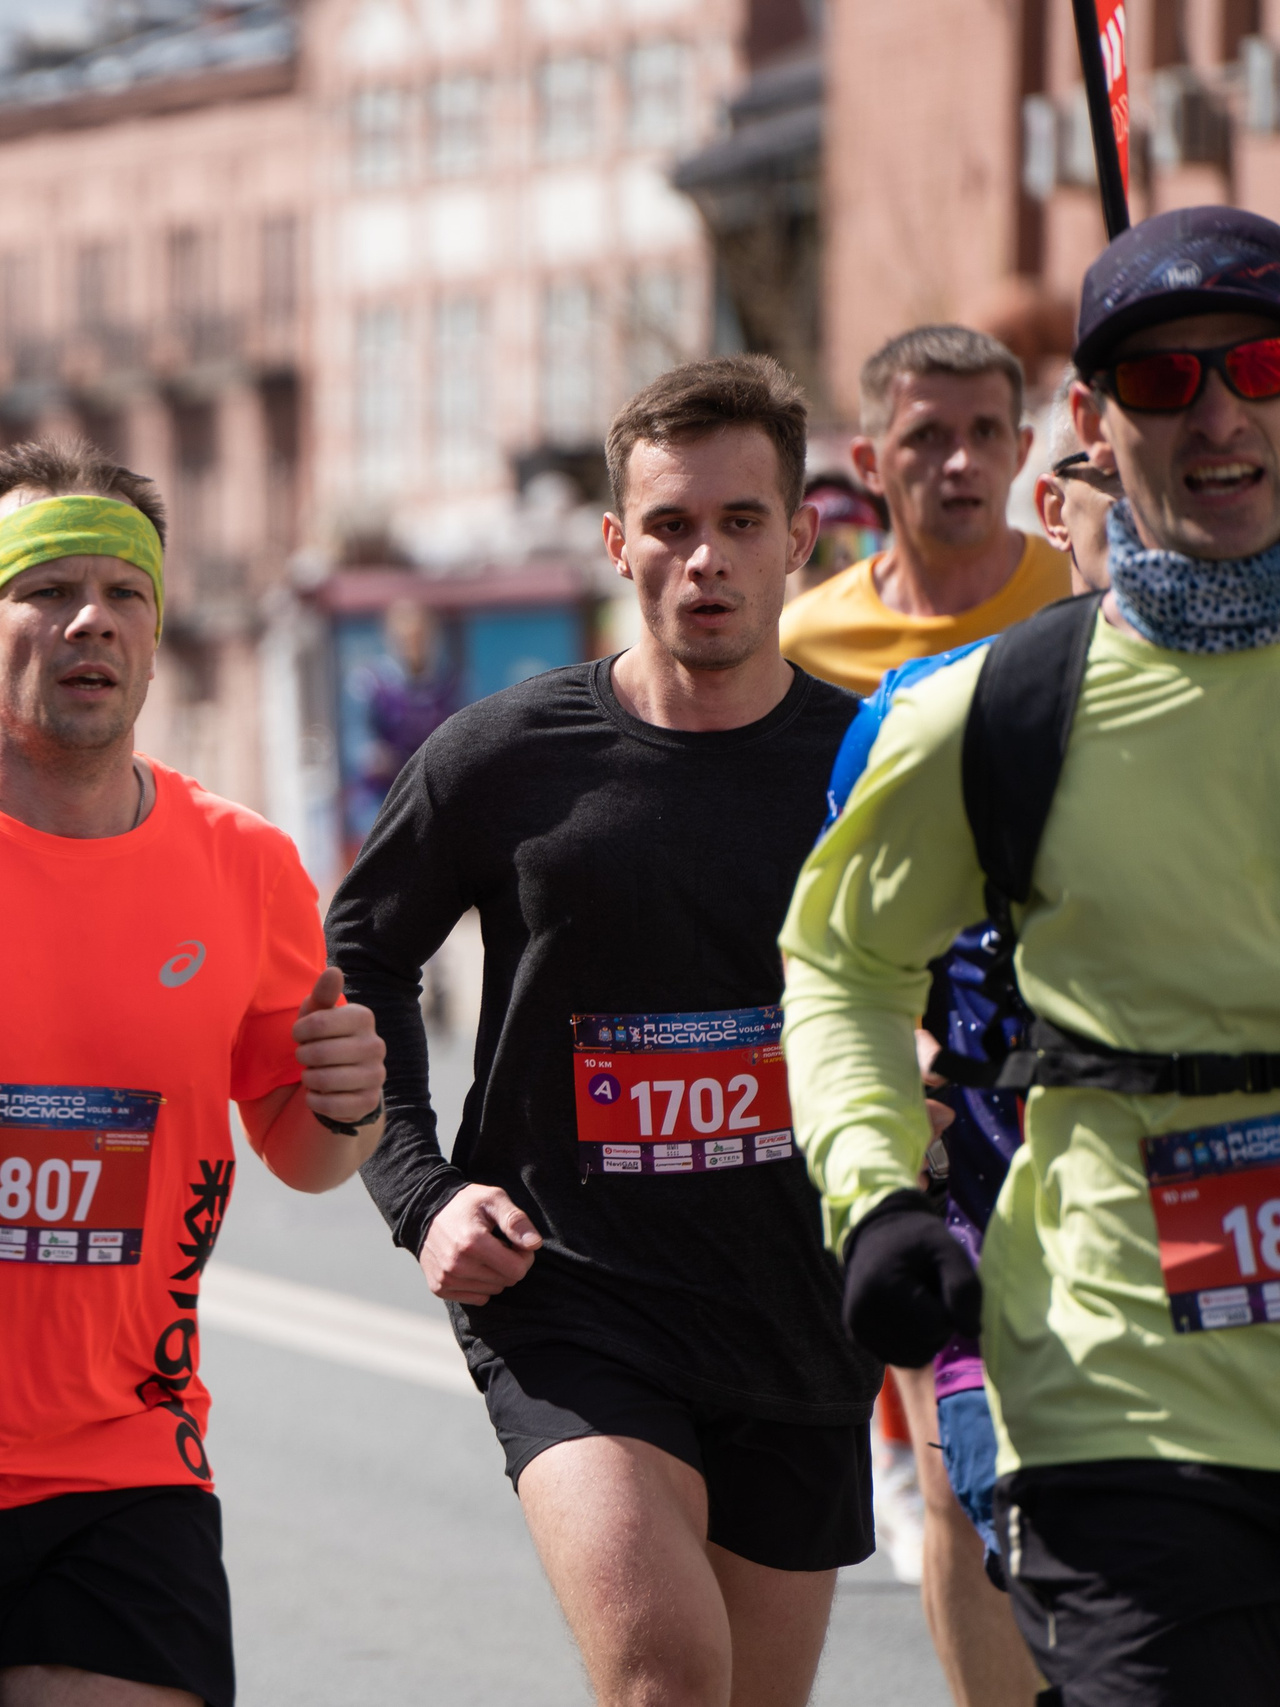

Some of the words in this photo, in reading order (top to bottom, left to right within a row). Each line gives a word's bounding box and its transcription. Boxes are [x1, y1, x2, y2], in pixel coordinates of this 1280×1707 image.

[643, 1023, 656, 1033] Я
[659, 1019, 737, 1032] ПРОСТО
[644, 1030, 738, 1044] КОСМОС
[584, 1059, 596, 1068] 10
[594, 1080, 613, 1100] A
[11, 1094, 87, 1107] ПРОСТО
[630, 1073, 761, 1136] 1702
[1246, 1124, 1280, 1142] ПР
